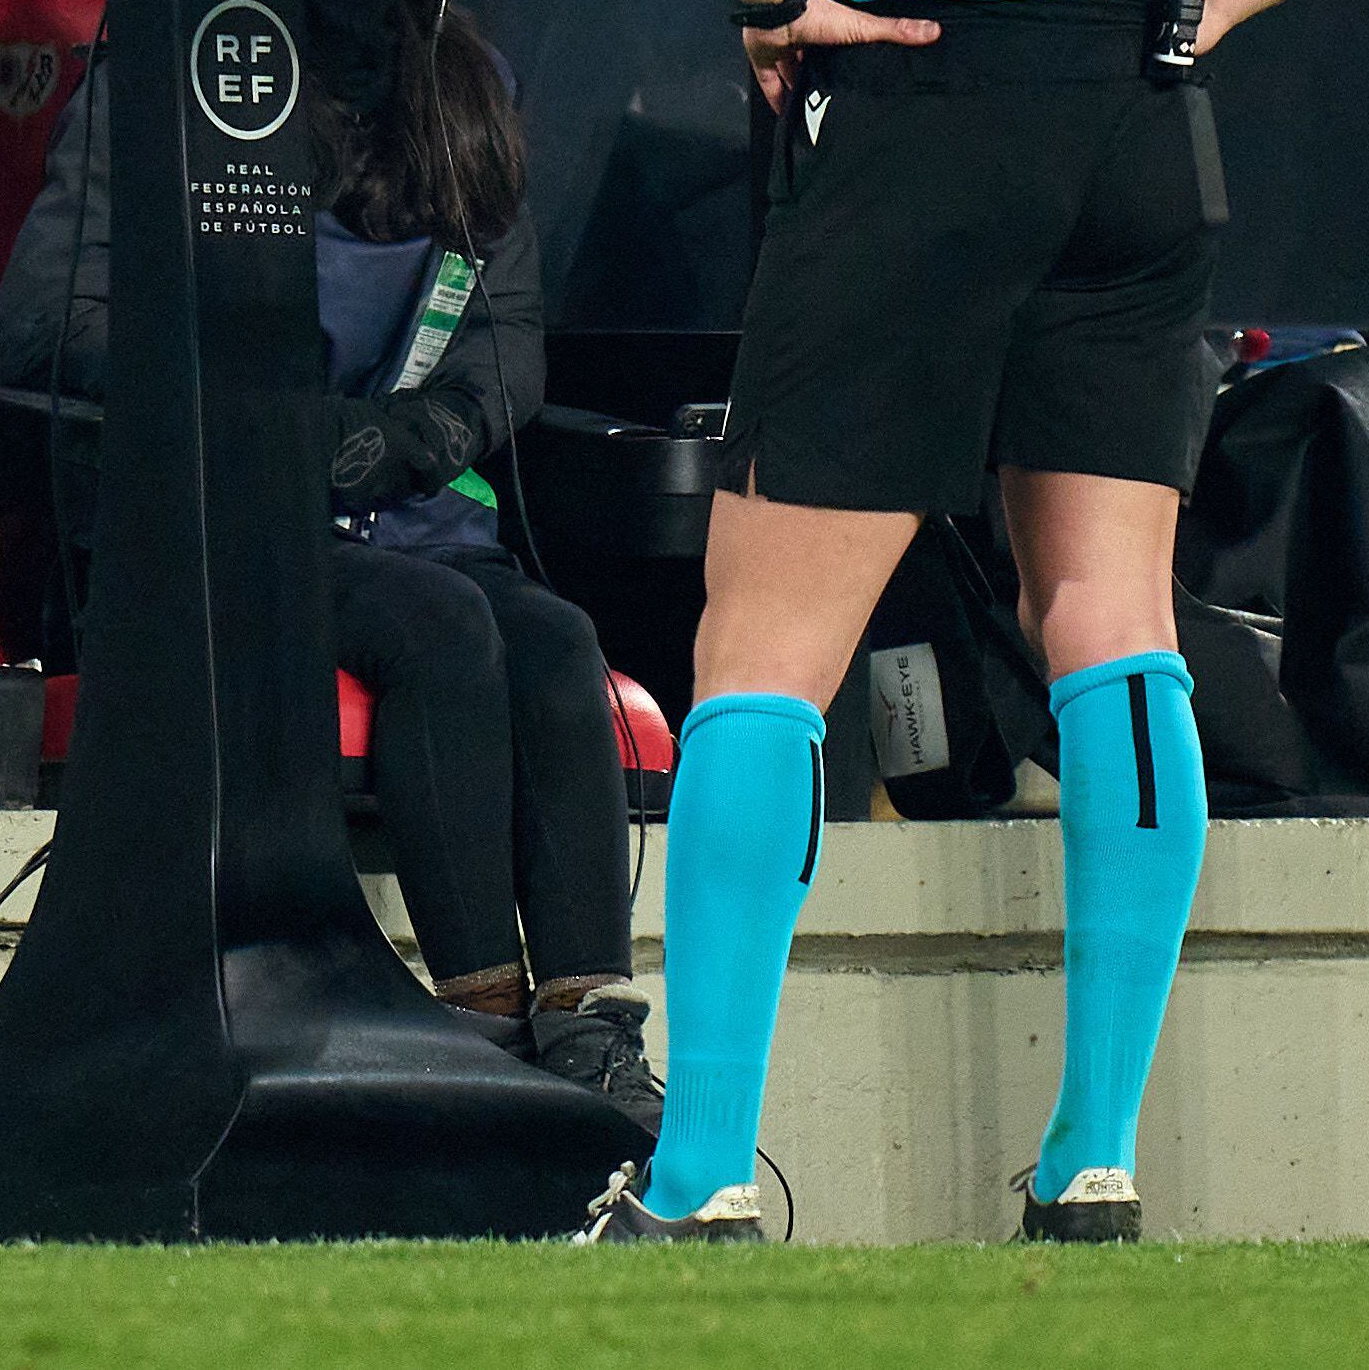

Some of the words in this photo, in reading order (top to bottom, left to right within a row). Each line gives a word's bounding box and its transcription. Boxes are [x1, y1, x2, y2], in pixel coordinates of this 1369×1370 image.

[226, 164, 274, 176] REAL
[190, 182, 312, 197] FEDERACIÓN
[202, 201, 301, 215] ESPAÑOLA
[201, 222, 222, 233] DE
[233, 219, 307, 235] FÚTBOL
[896, 655, 924, 765] HAWK-EYE
